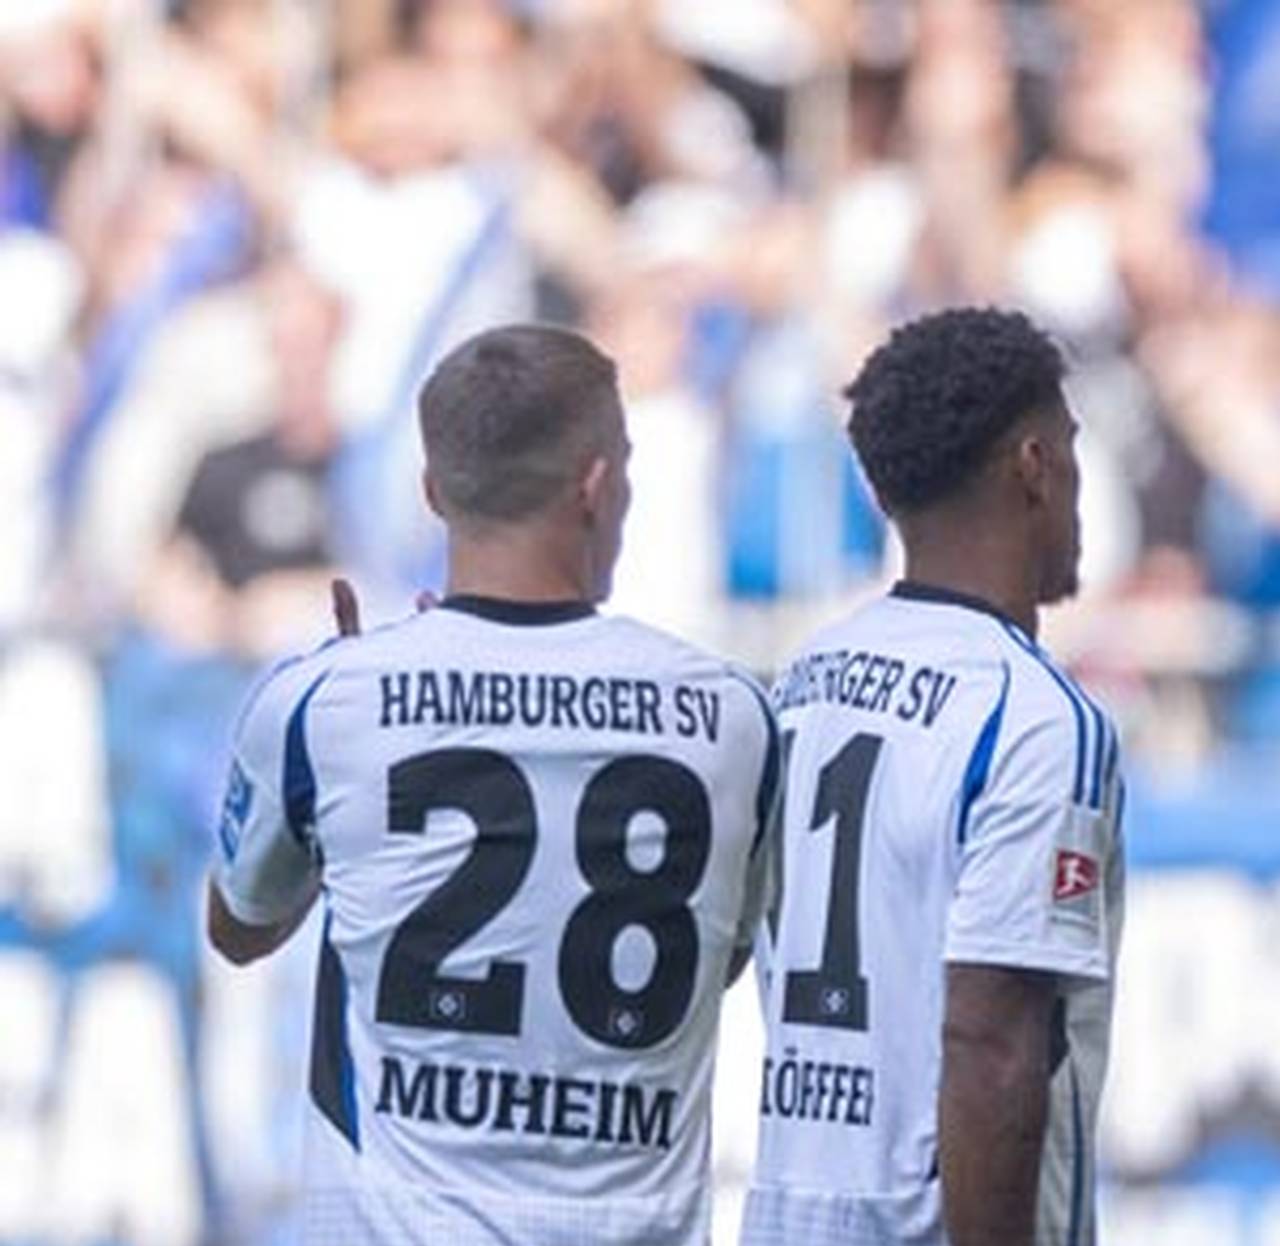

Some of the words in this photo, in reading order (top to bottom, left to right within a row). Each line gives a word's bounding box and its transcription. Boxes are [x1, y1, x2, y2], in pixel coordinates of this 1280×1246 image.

[378, 669, 665, 736] HAMBURGER
[673, 684, 720, 743] SV
[896, 665, 958, 728] SV
[374, 746, 713, 1050] 28
[375, 1055, 677, 1150] MUHEIM
